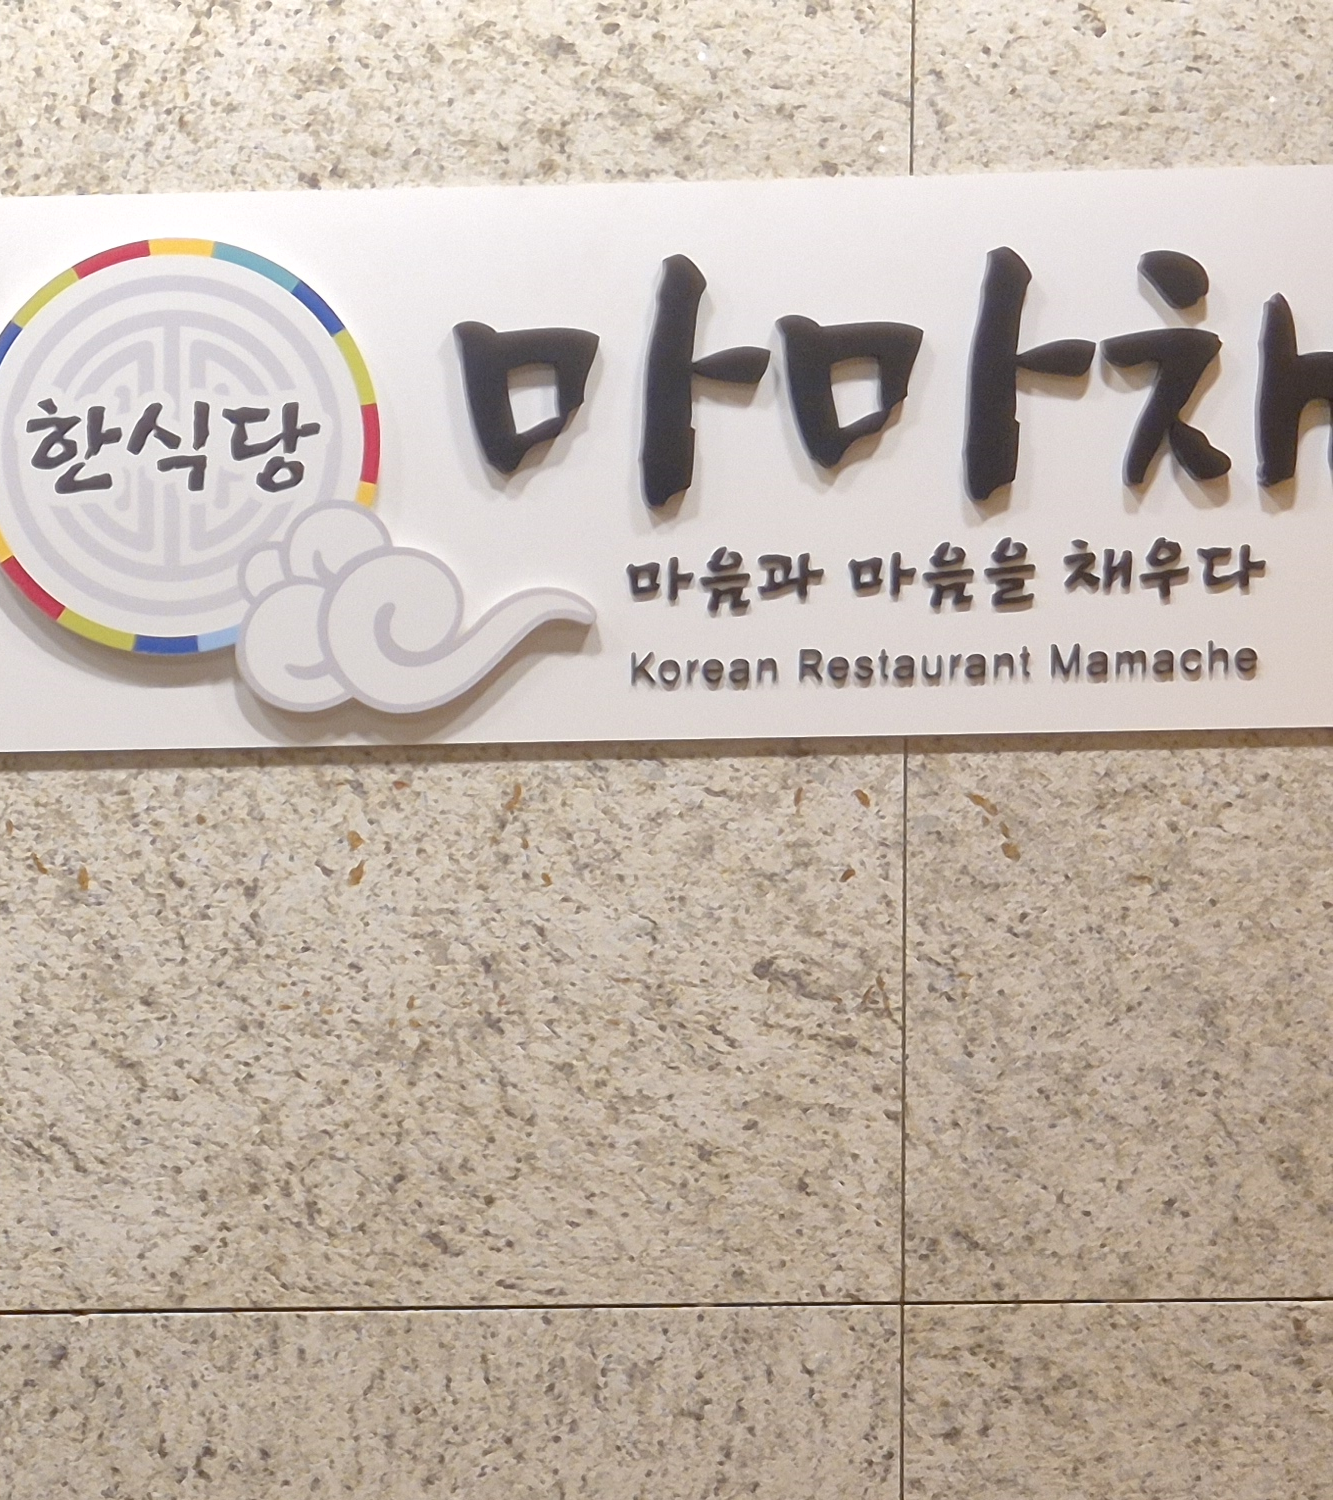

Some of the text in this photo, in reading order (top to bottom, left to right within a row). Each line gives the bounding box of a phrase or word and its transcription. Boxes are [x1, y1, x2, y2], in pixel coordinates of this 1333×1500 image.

[25, 398, 322, 494] 한식당
[626, 536, 1267, 617] 마음과 마음을 채우다
[630, 640, 1260, 690] Korean Restaurant Mamache
